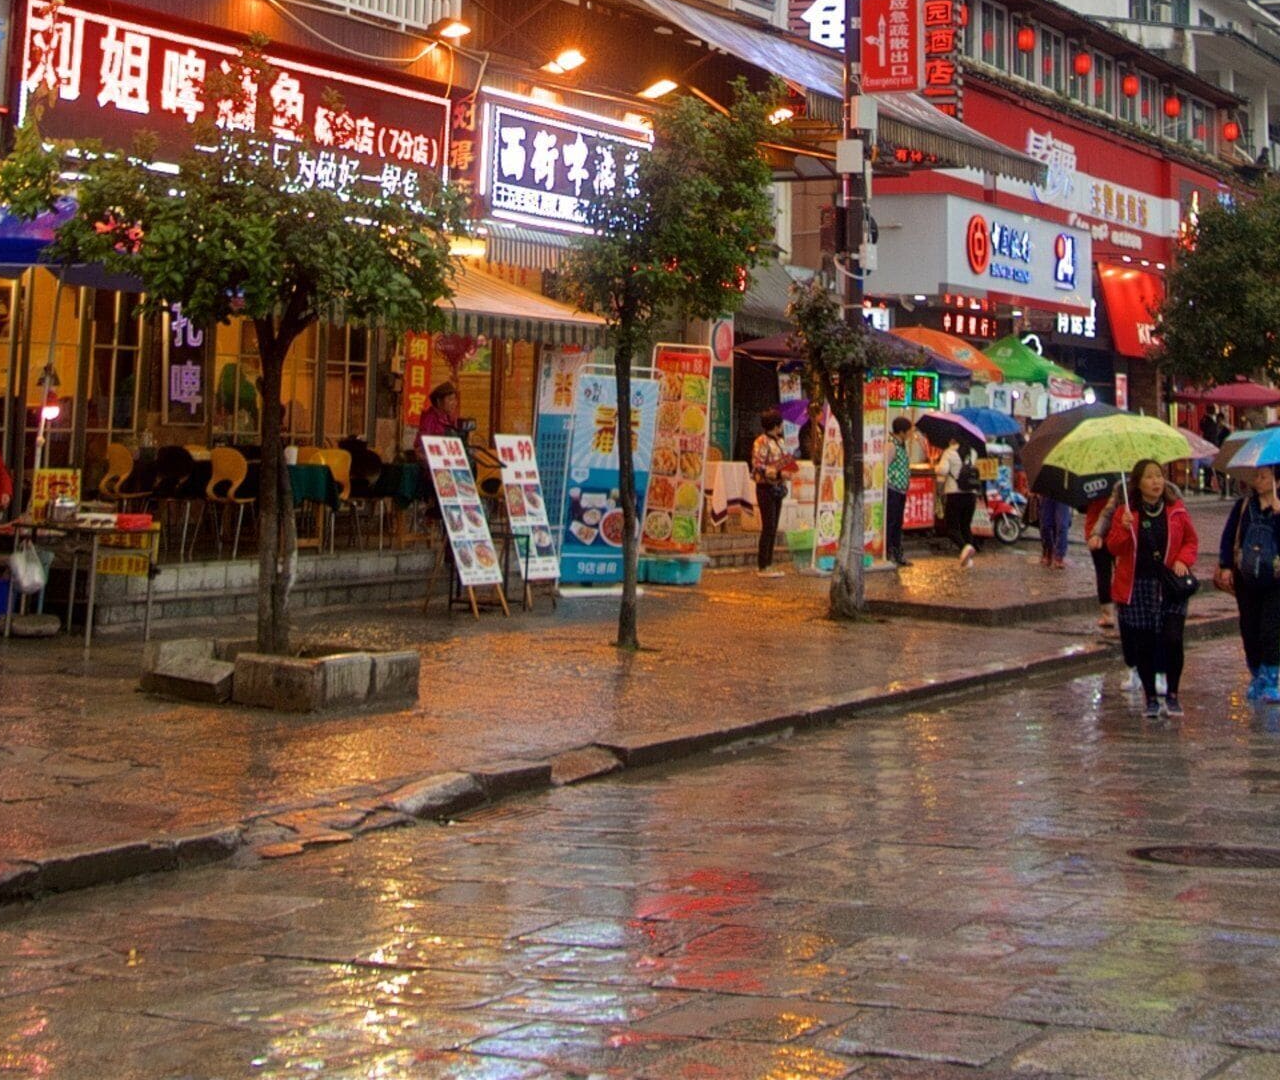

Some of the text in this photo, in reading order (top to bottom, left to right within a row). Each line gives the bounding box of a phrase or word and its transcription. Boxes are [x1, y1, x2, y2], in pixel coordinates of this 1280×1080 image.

[28, 14, 305, 142] 刘姐啤酒鱼
[171, 301, 204, 415] 扎啤
[517, 440, 533, 460] 99
